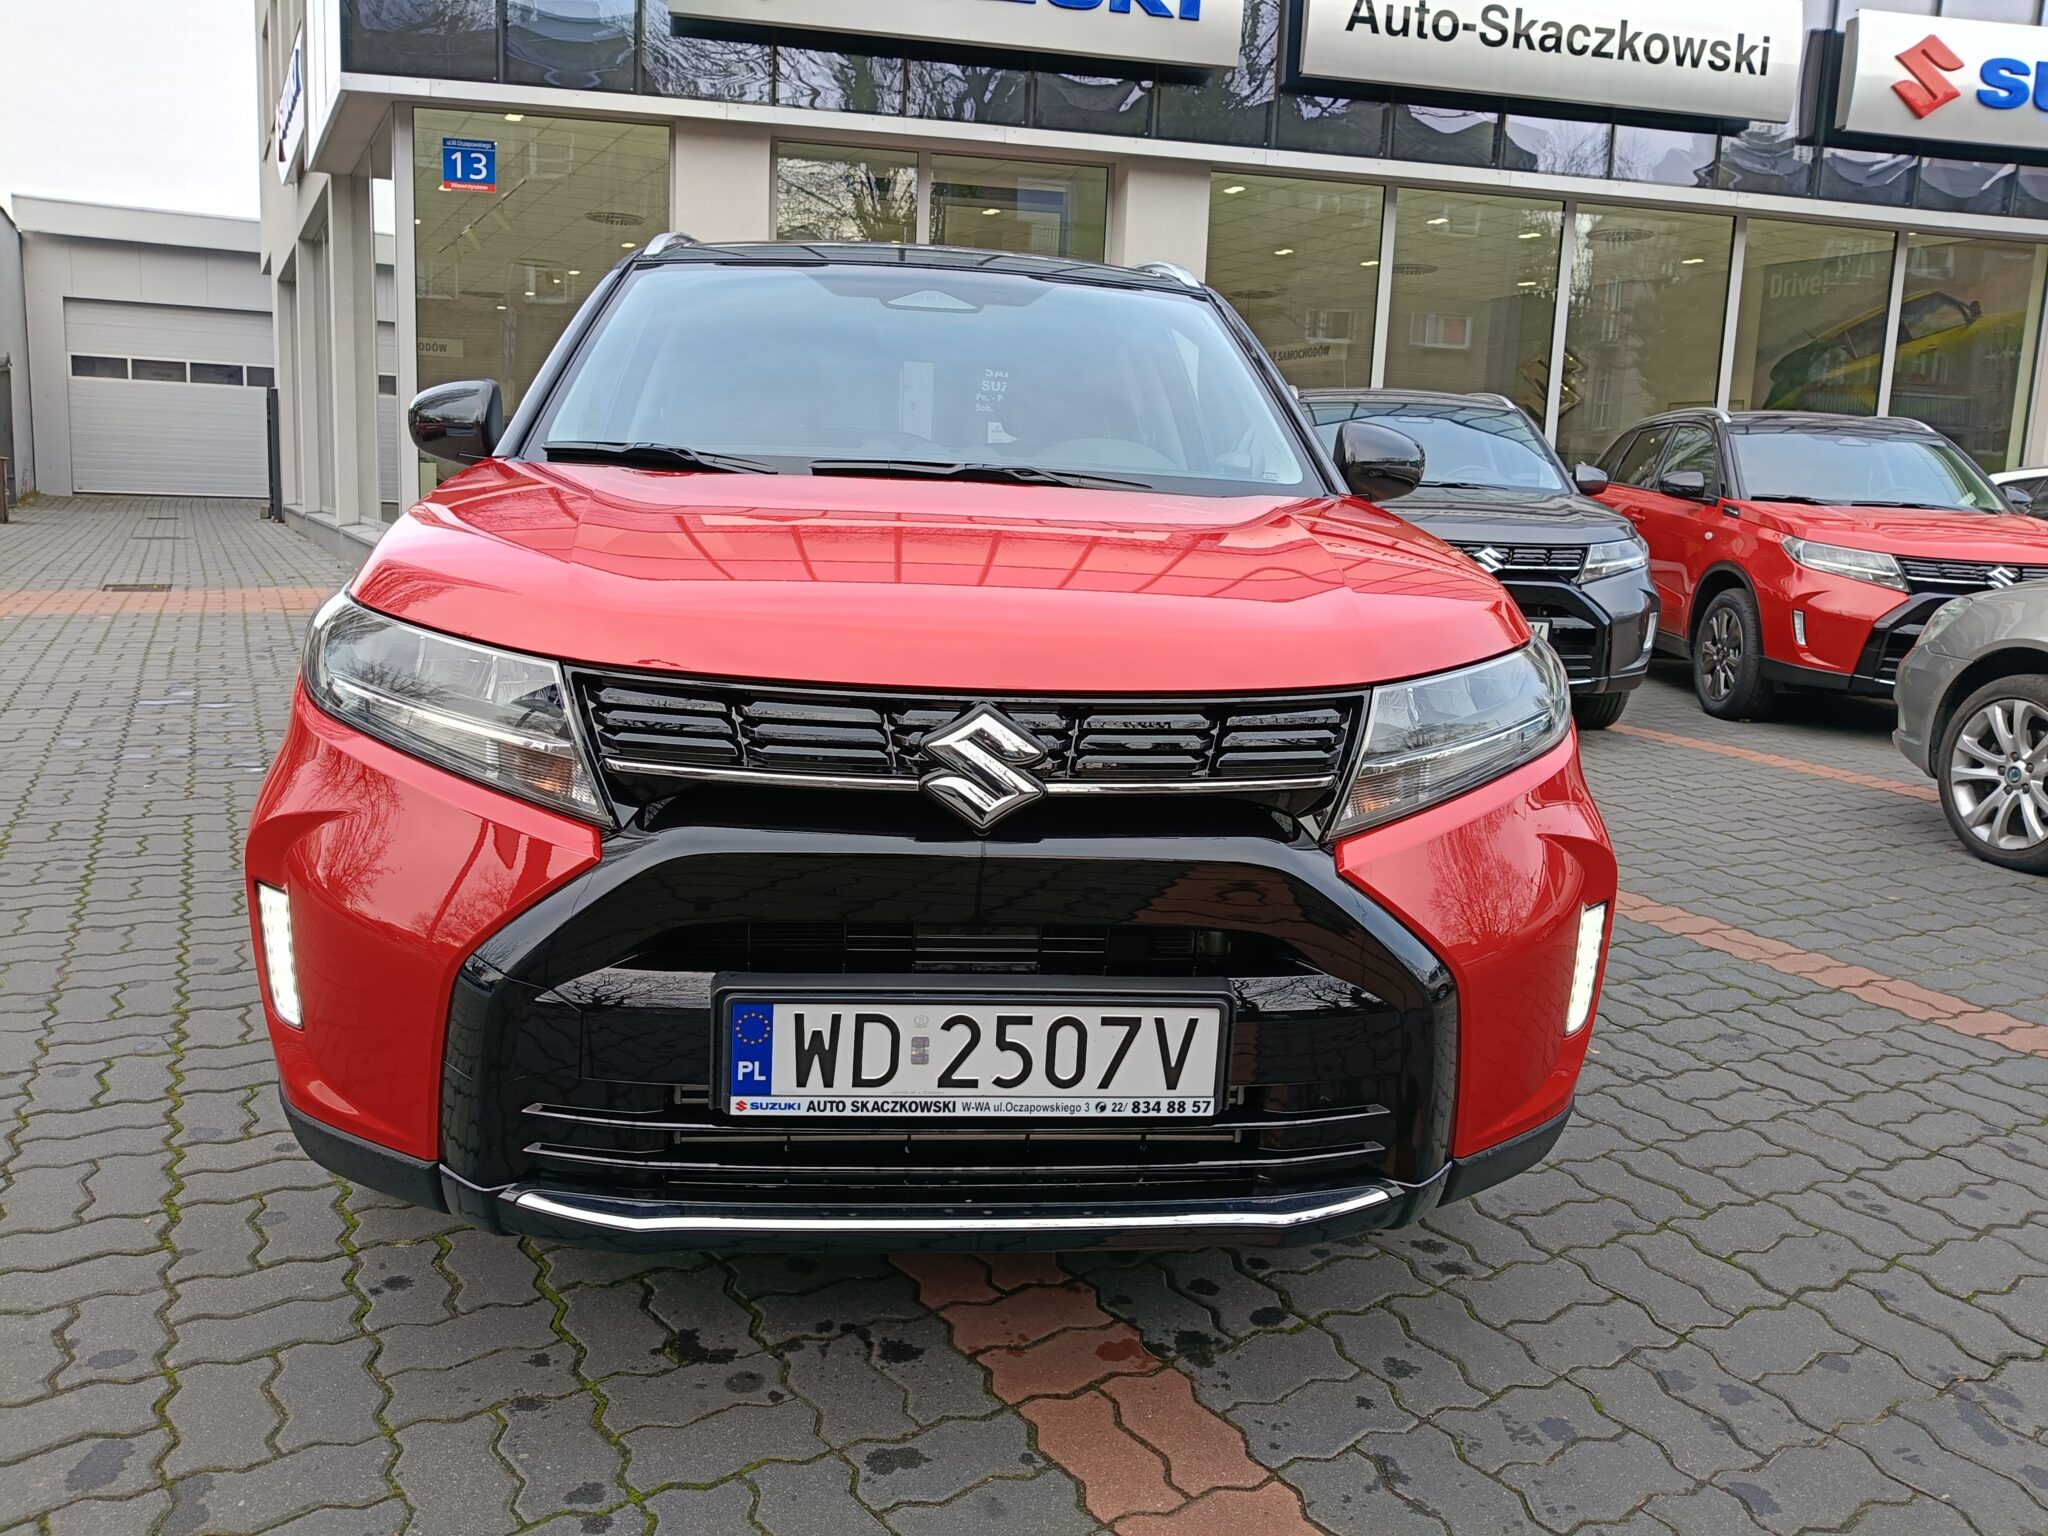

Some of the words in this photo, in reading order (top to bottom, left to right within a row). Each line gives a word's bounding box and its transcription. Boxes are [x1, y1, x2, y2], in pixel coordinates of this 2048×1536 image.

[1345, 0, 1771, 77] Auto-Skaczkowski
[1976, 57, 2048, 113] S
[451, 151, 488, 180] 13
[1769, 268, 1829, 299] Drive!
[1278, 344, 1331, 361] SAMOCHODÓW
[794, 1012, 900, 1089] WD
[937, 1012, 1199, 1090] 2507V
[737, 1061, 767, 1081] PL
[749, 1101, 801, 1111] SUZUKI
[806, 1099, 846, 1113] AUTO
[850, 1100, 957, 1113] SKACZKOWSKI
[961, 1101, 991, 1113] W-WA
[1084, 1102, 1091, 1113] 3
[1111, 1102, 1128, 1113] 22/
[1131, 1100, 1162, 1114] 834
[1166, 1100, 1187, 1114] 88
[1191, 1100, 1212, 1114] 57
